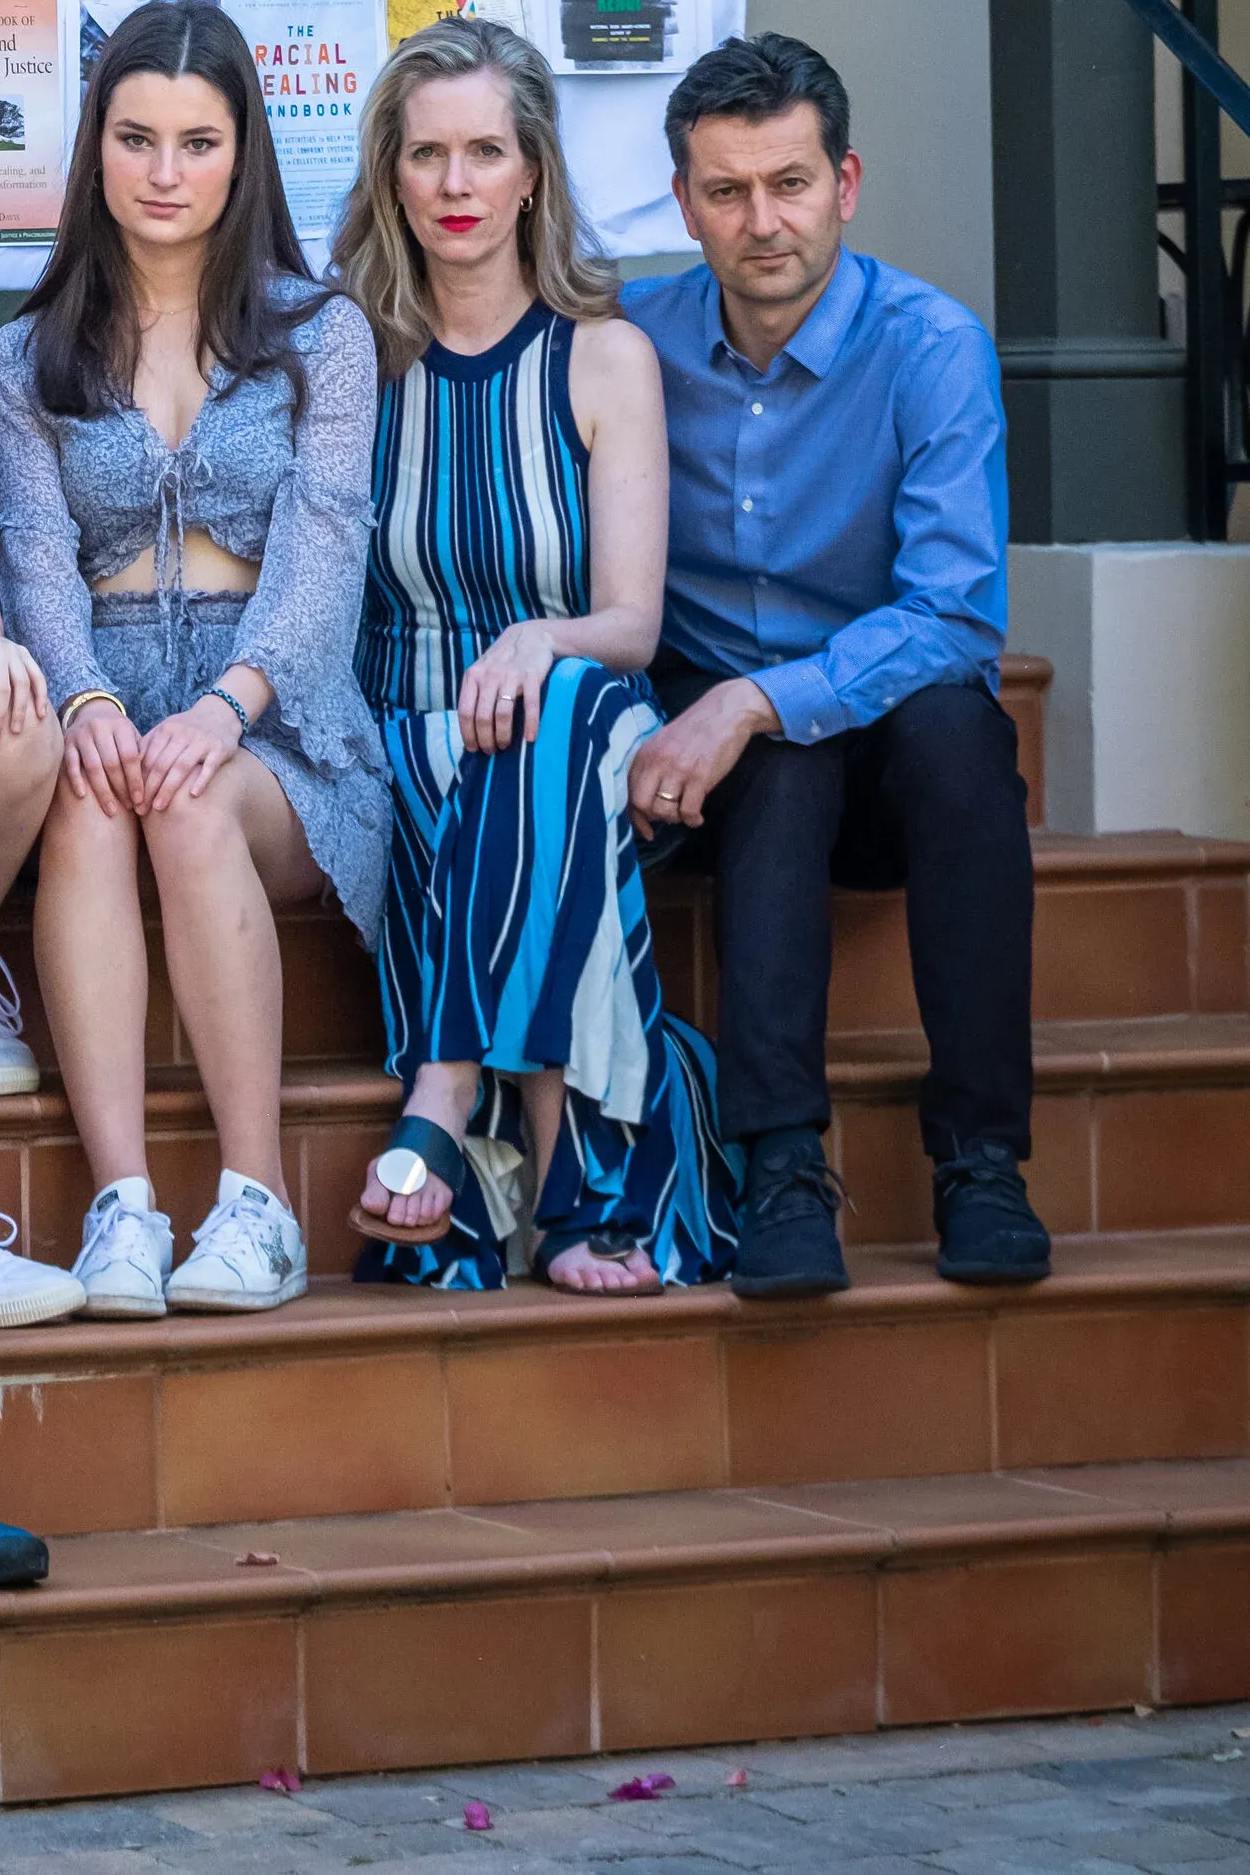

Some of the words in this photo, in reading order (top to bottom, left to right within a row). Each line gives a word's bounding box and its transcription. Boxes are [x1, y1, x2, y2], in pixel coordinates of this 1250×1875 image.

[21, 16, 35, 26] OF
[288, 25, 314, 37] THE
[254, 43, 347, 66] RACIAL
[4, 56, 53, 78] Justice
[263, 72, 358, 96] EALING
[266, 103, 352, 117] ANDBOOK
